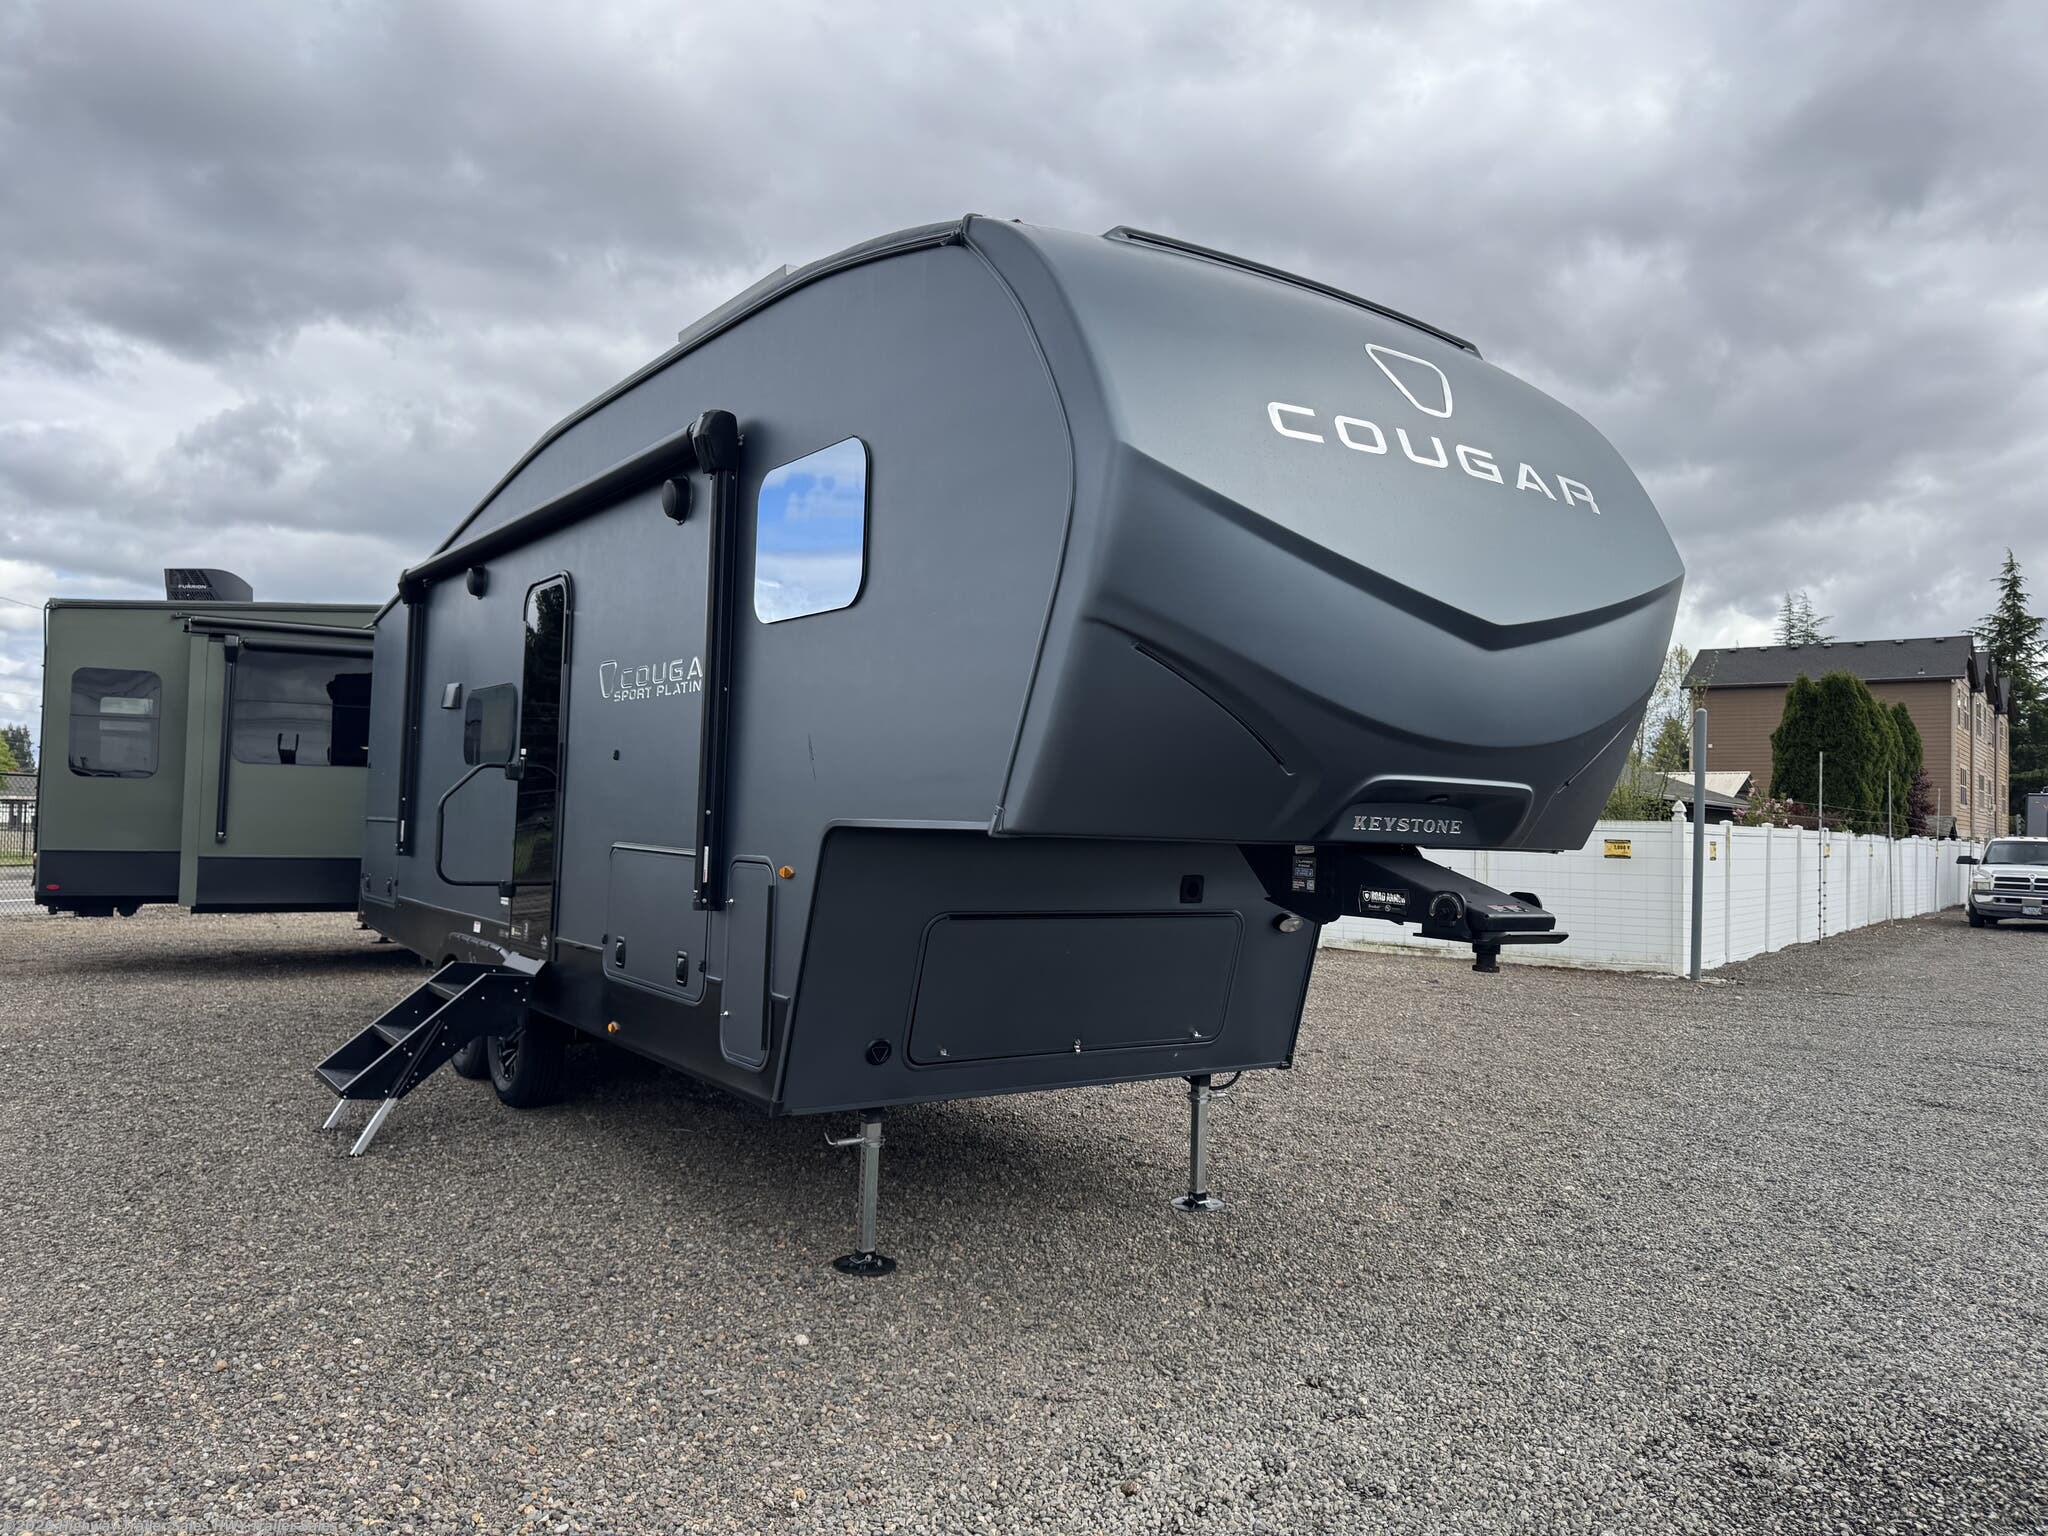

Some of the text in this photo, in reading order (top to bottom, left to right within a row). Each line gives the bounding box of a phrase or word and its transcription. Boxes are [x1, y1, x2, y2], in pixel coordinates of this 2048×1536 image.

[1267, 401, 1601, 515] COUGAR
[620, 656, 704, 689] COUGA
[613, 679, 702, 702] SPORT PLATIN
[1353, 815, 1463, 834] KEYSTONE
